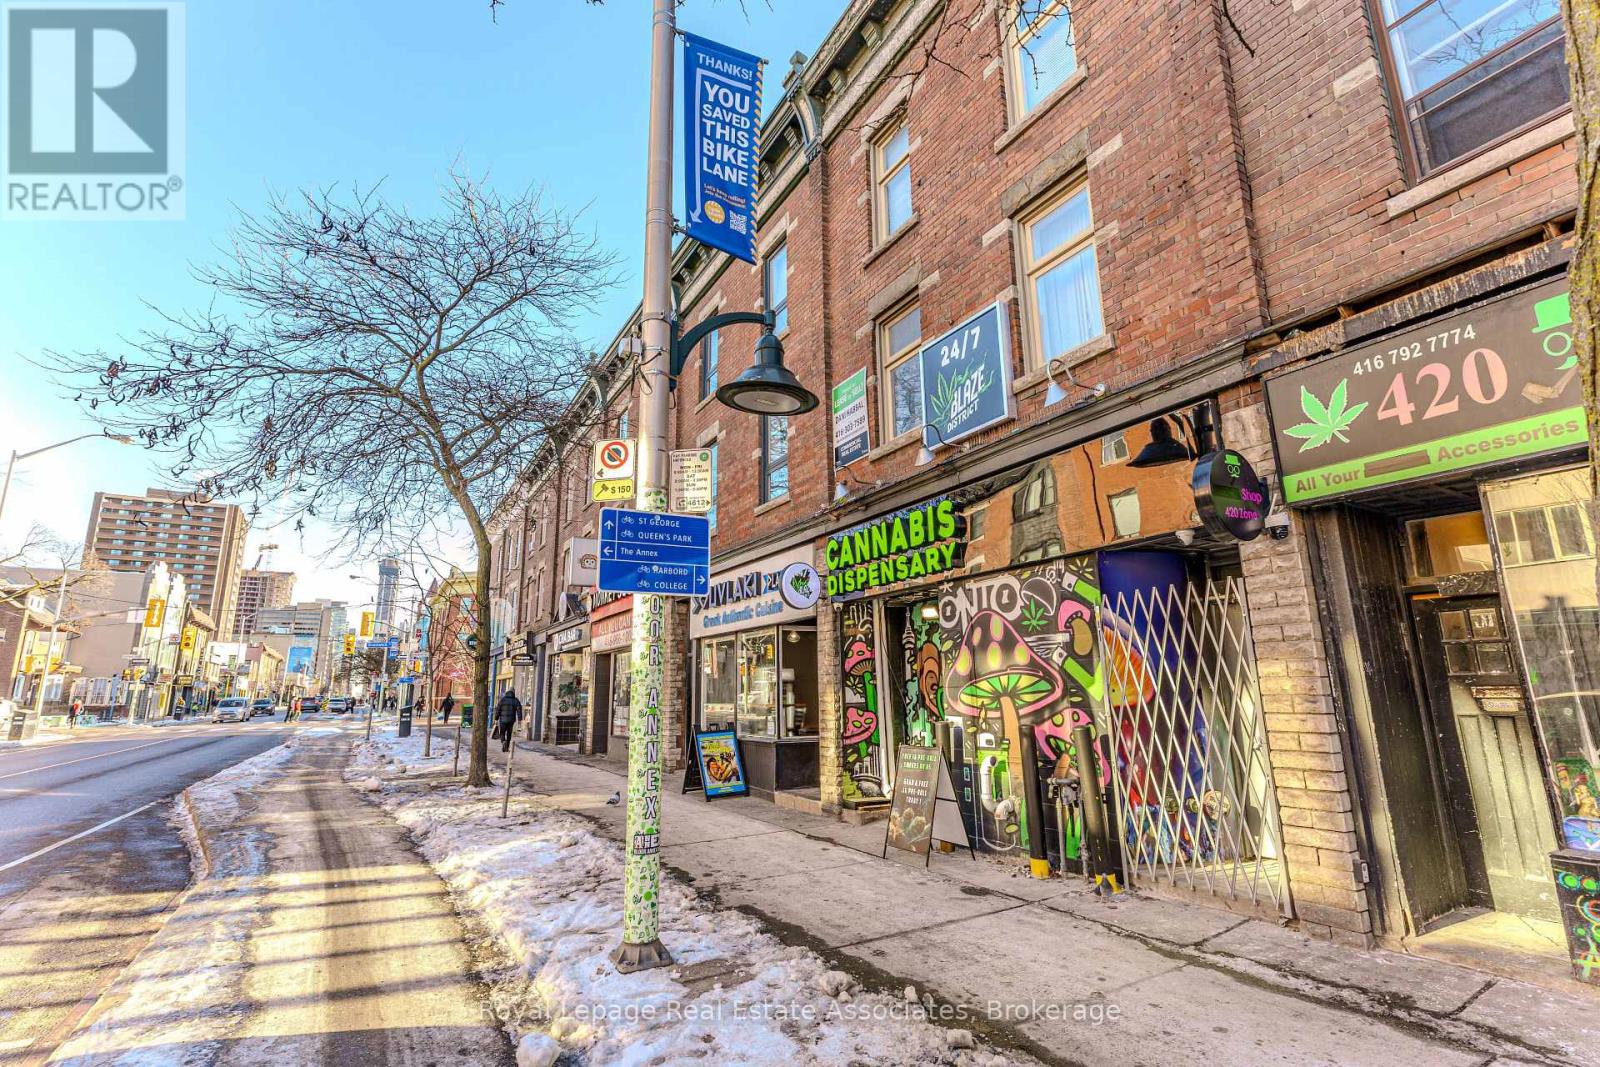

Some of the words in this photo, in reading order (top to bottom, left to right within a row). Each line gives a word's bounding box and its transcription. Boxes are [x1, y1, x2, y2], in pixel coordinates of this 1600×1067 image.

[697, 52, 752, 80] THANKS!
[703, 80, 750, 114] YOU
[702, 104, 750, 129] SAVED
[702, 118, 749, 148] THIS
[702, 137, 749, 168] BIKE
[702, 156, 748, 187] LANE
[941, 326, 980, 367] 24/7
[1353, 358, 1384, 377] 416
[1389, 341, 1423, 365] 792
[1426, 324, 1476, 354] 7774
[1376, 348, 1508, 427] 420
[947, 399, 980, 433] DISTRICT
[1296, 476, 1316, 495] All
[1321, 467, 1361, 488] Your
[1437, 418, 1580, 463] Accessories
[1241, 487, 1262, 505] Shop
[638, 517, 647, 525] ST
[649, 518, 680, 528] GEORGE
[1225, 505, 1238, 517] 420
[1239, 508, 1258, 520] Zone
[638, 532, 670, 541] QUEEN'S
[673, 534, 692, 543] PARK
[826, 500, 955, 571] CANNABIS
[621, 547, 634, 555] The
[636, 549, 658, 557] Annex
[827, 542, 956, 596] DISPENSARY
[654, 582, 688, 590] COLLEGE
[645, 687, 660, 819] ANNEX
